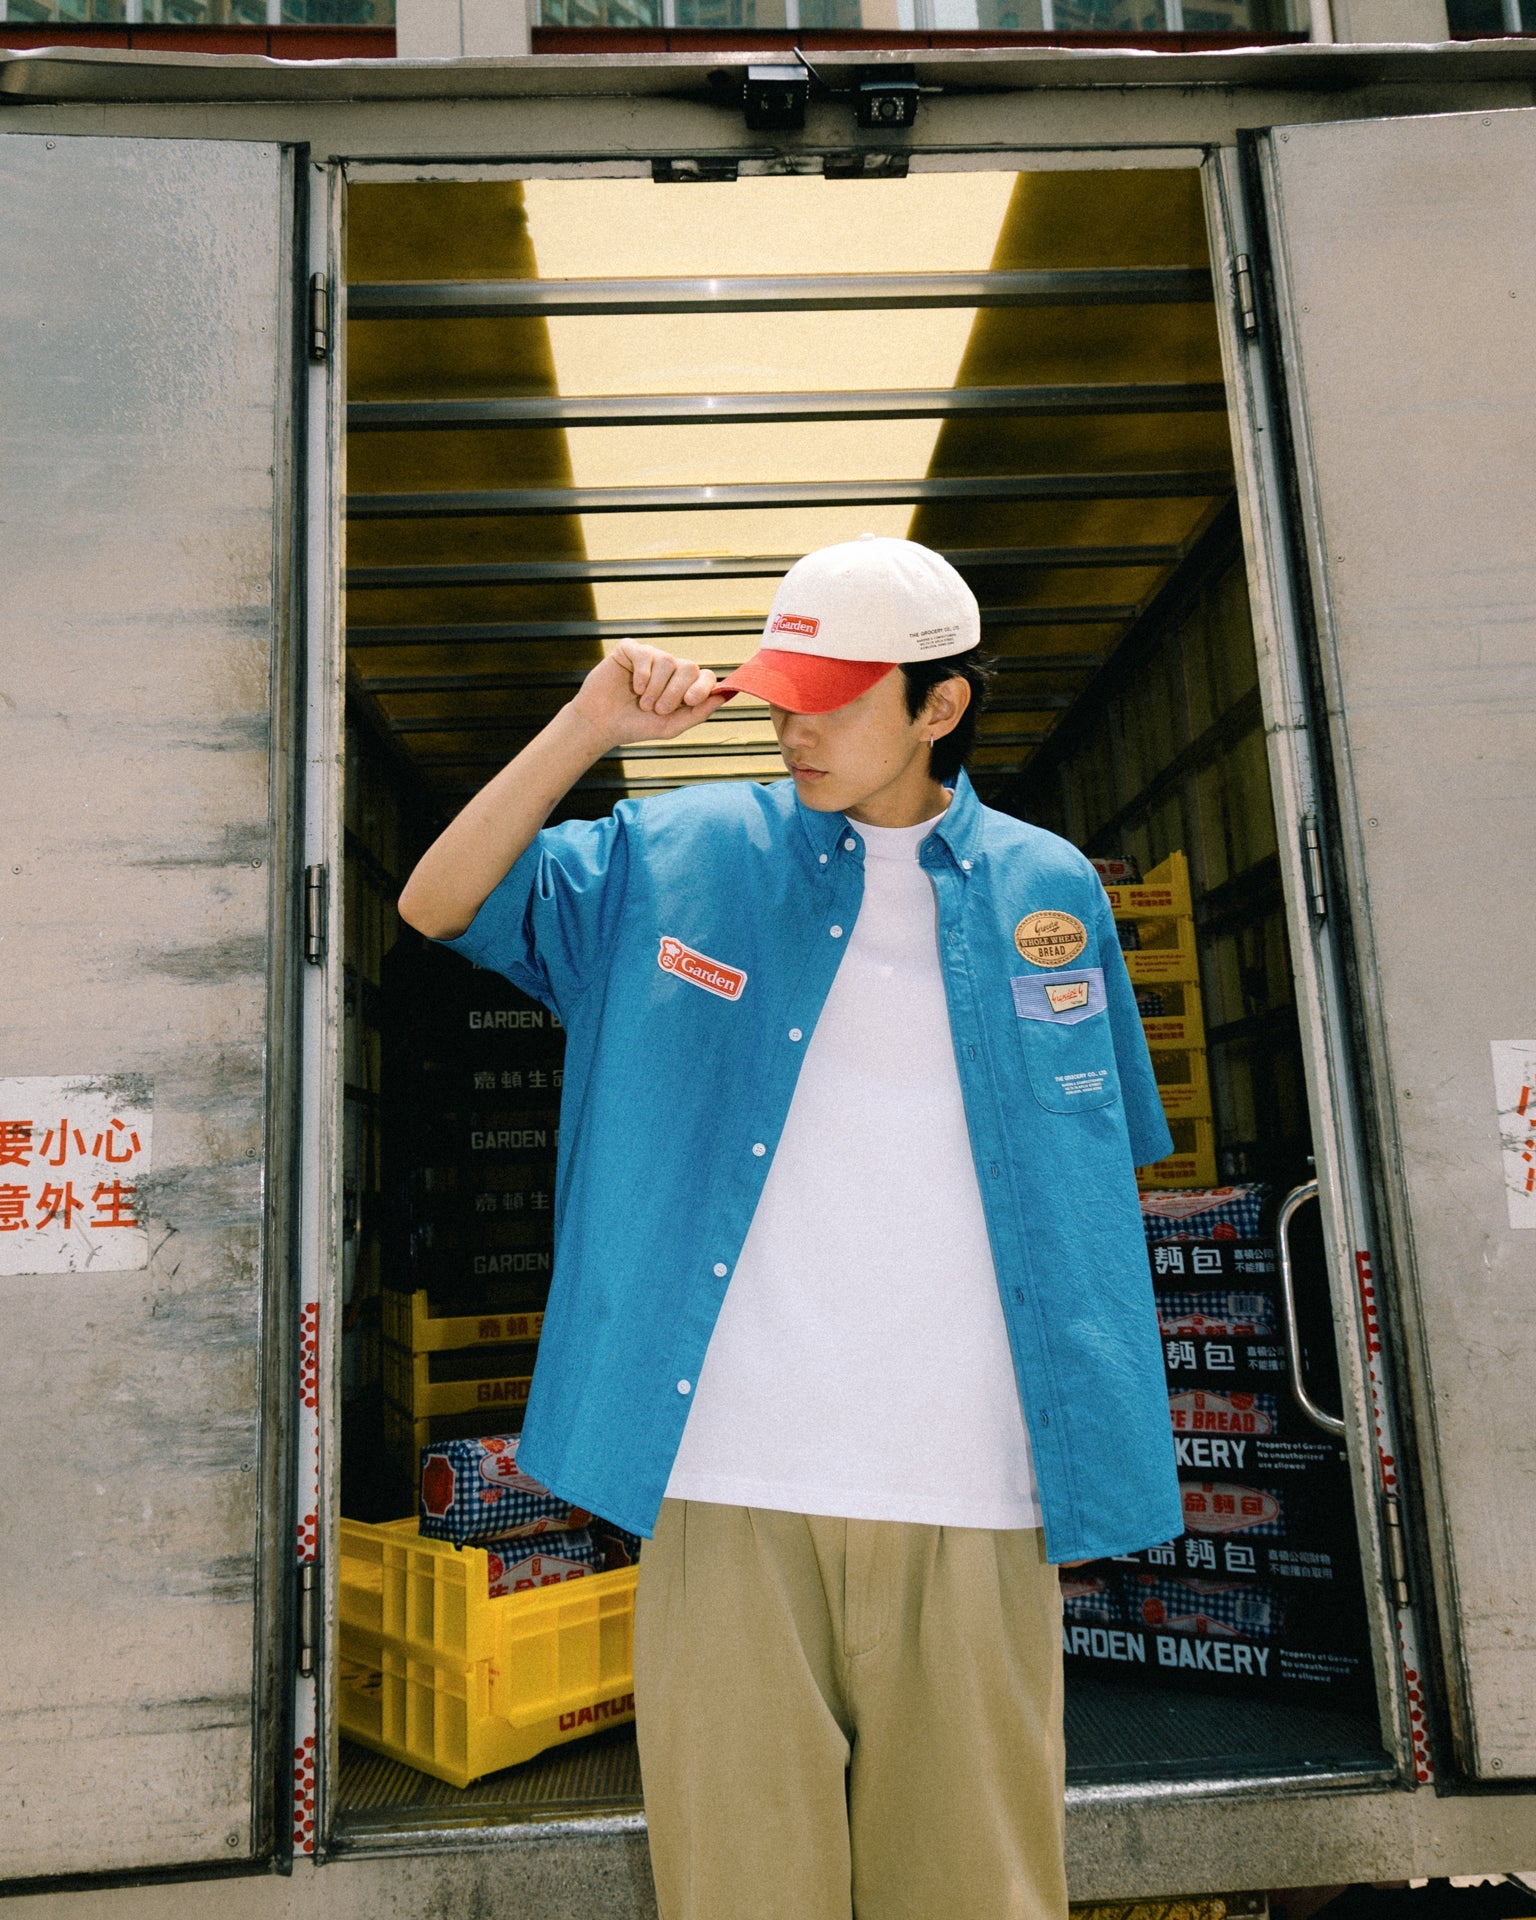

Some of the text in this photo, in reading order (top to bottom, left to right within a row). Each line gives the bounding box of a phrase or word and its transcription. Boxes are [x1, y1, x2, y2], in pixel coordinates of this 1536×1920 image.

[779, 616, 814, 634] Garden
[1020, 933, 1081, 947] WHOLE WHEAT
[1038, 945, 1066, 957] BREAD
[680, 957, 736, 992] Garden
[469, 1010, 543, 1029] GARDEN
[0, 1118, 141, 1167] 要小心
[471, 1130, 546, 1150] GARDEN
[473, 1253, 549, 1275] GARDEN
[1153, 1246, 1223, 1274] 麵包
[1166, 1340, 1236, 1371] 麵包
[1192, 1411, 1255, 1432] BREAD
[1174, 1437, 1247, 1469] KERY
[1256, 1440, 1333, 1451] Property of Garden
[1257, 1450, 1324, 1461] No unauthorized
[1274, 1461, 1306, 1470] allowed
[1156, 1635, 1269, 1677] BAKERY
[1279, 1648, 1317, 1660] Property
